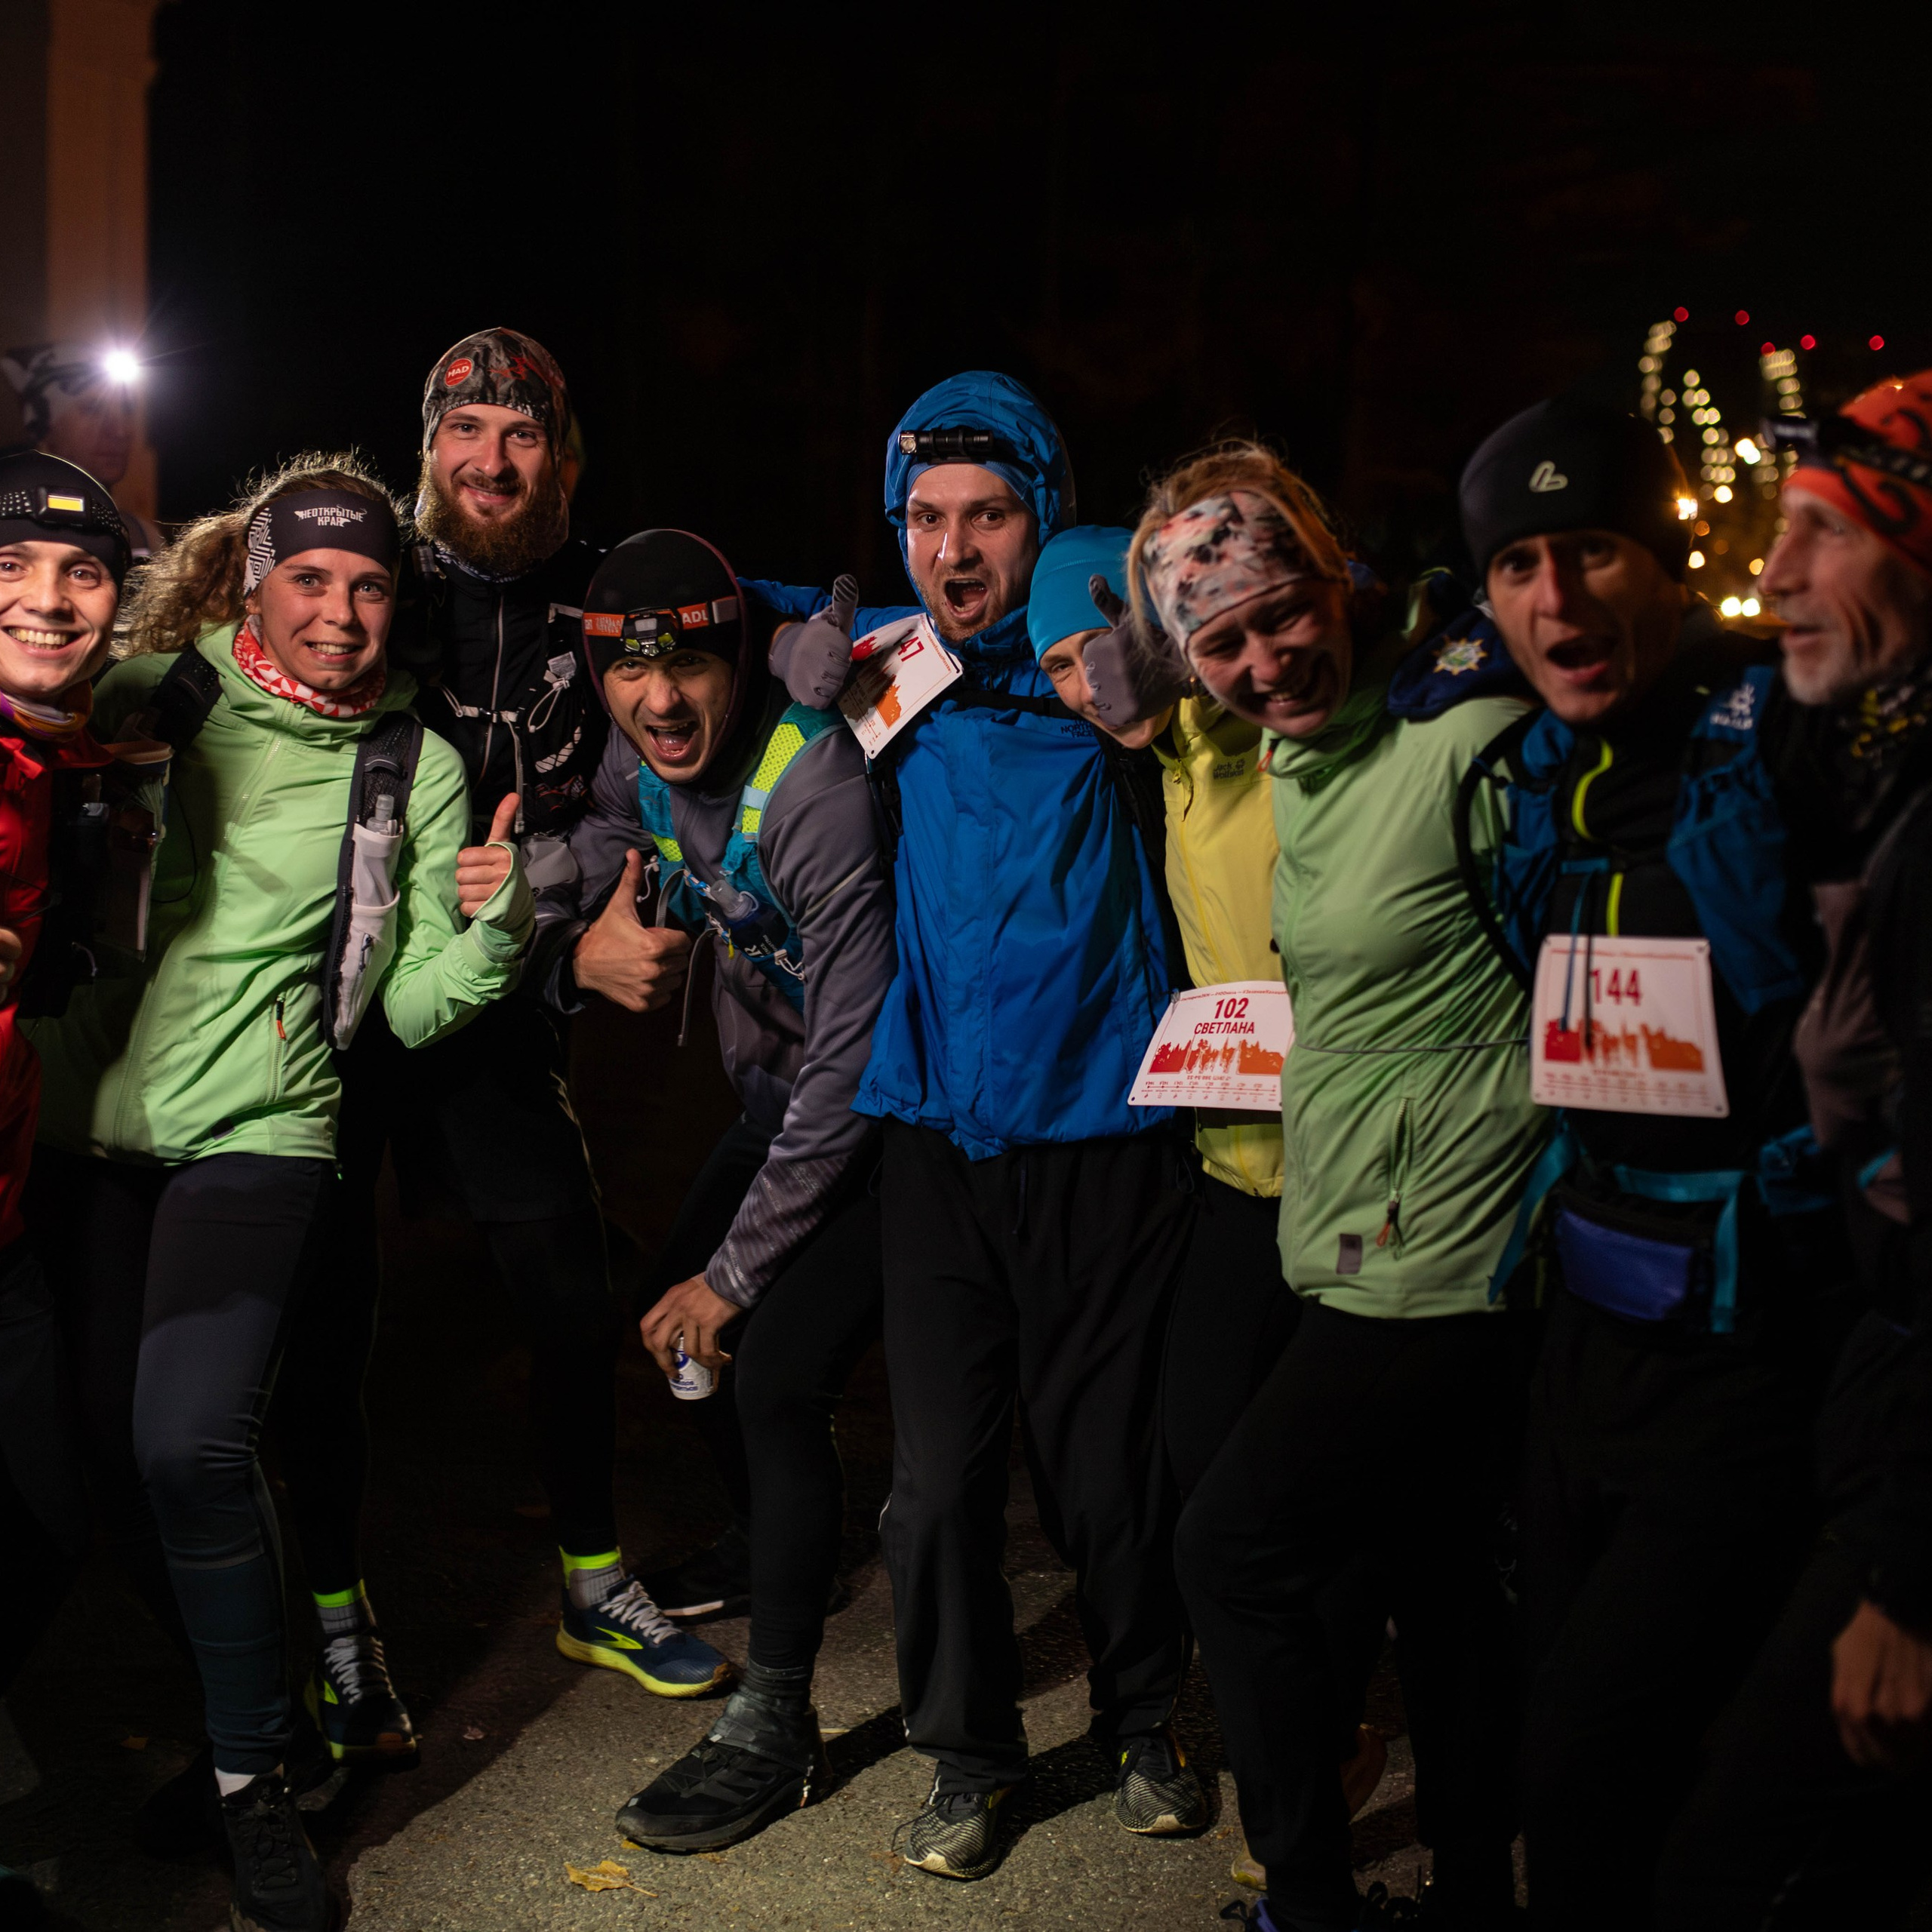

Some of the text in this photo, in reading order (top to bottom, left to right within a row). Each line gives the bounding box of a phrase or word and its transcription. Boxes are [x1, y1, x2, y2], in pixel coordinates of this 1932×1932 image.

[448, 366, 469, 378] HAD
[297, 505, 367, 522] НЕОТКРЫТЫЕ
[1589, 968, 1641, 1007] 144
[1214, 998, 1249, 1019] 102
[1194, 1021, 1255, 1035] СВЕТЛАНА
